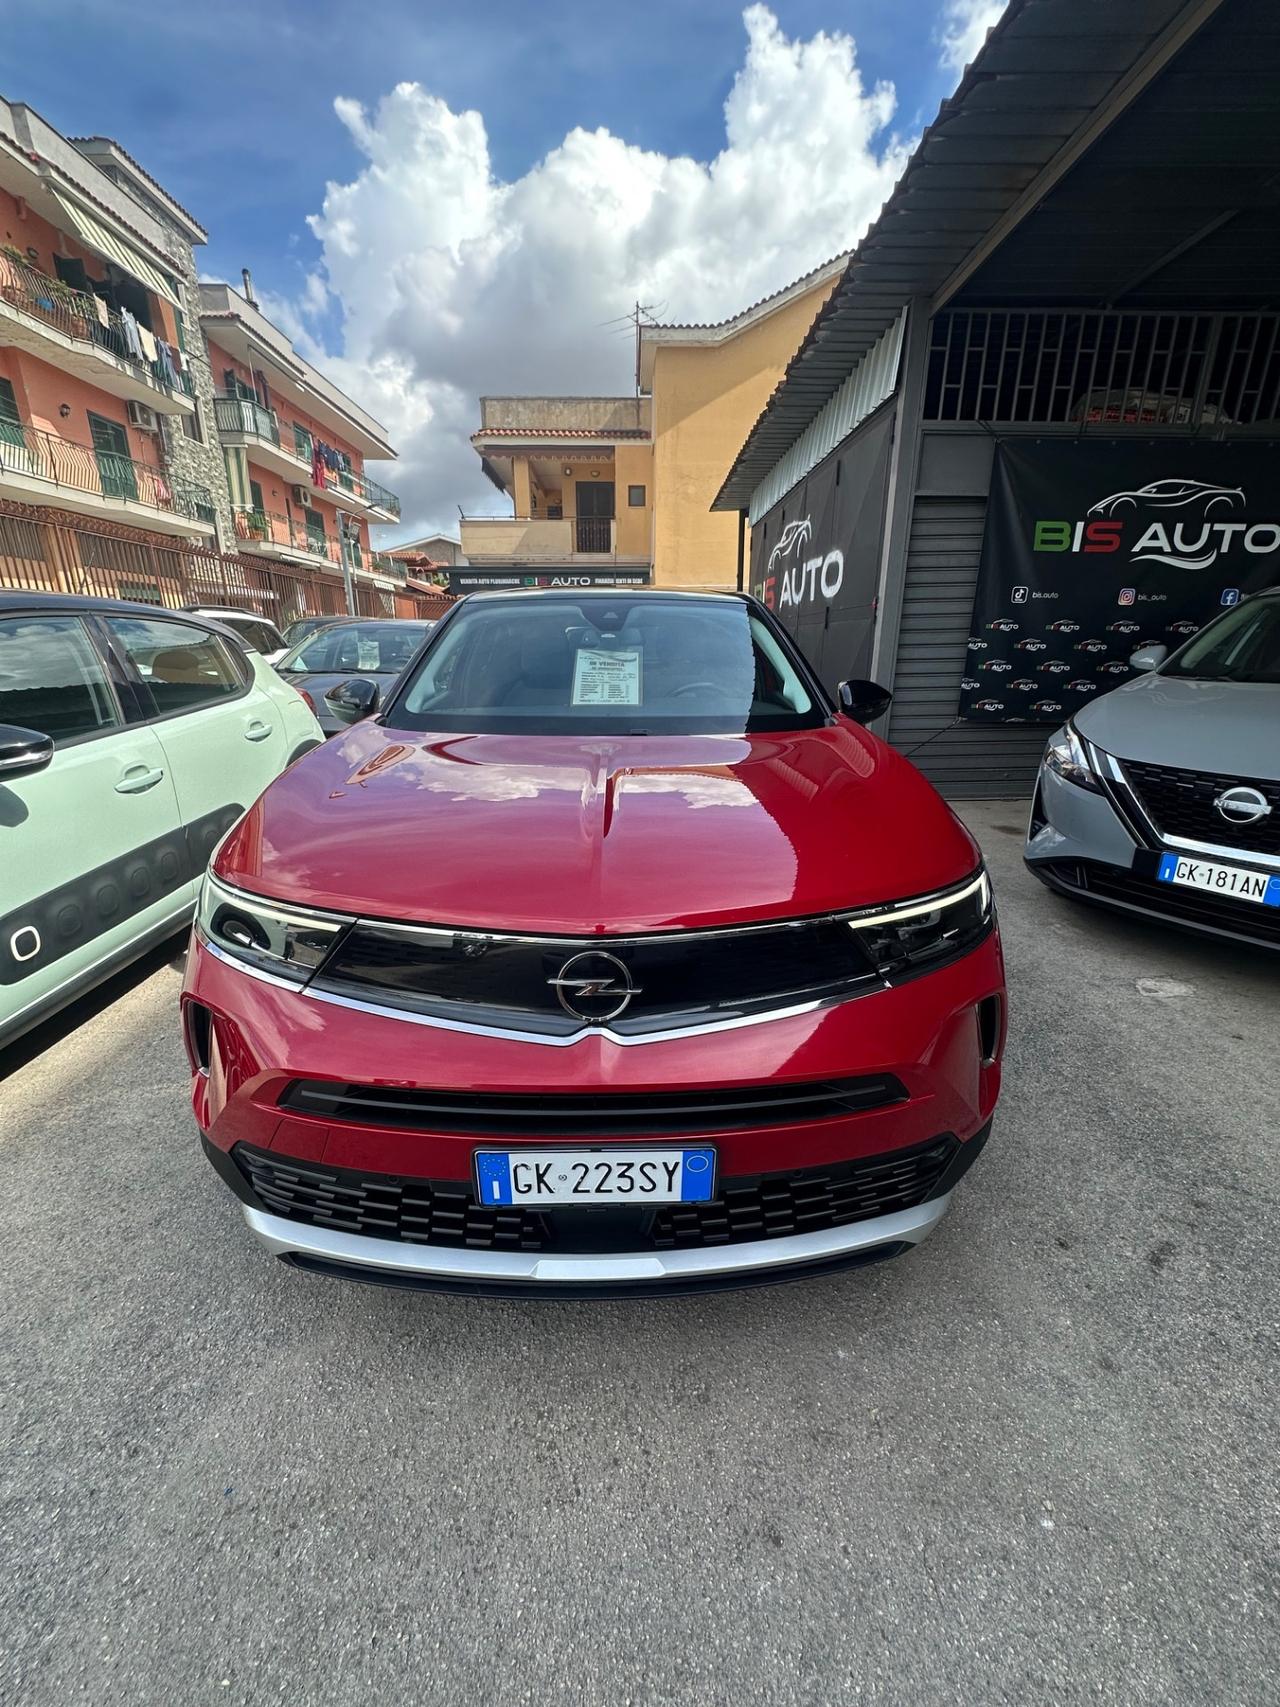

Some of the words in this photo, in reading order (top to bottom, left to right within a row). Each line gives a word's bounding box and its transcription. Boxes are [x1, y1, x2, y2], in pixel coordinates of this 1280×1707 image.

[1033, 520, 1123, 552] BIS
[1131, 522, 1280, 553] AUTO
[524, 577, 548, 586] BIS
[551, 577, 591, 586] AUTO
[779, 549, 844, 612] AUTO
[1032, 591, 1060, 600] bis.auto
[1176, 862, 1199, 882] GK
[1206, 868, 1266, 897] 181AN
[512, 1162, 555, 1194] GK
[571, 1161, 680, 1194] 223SY
